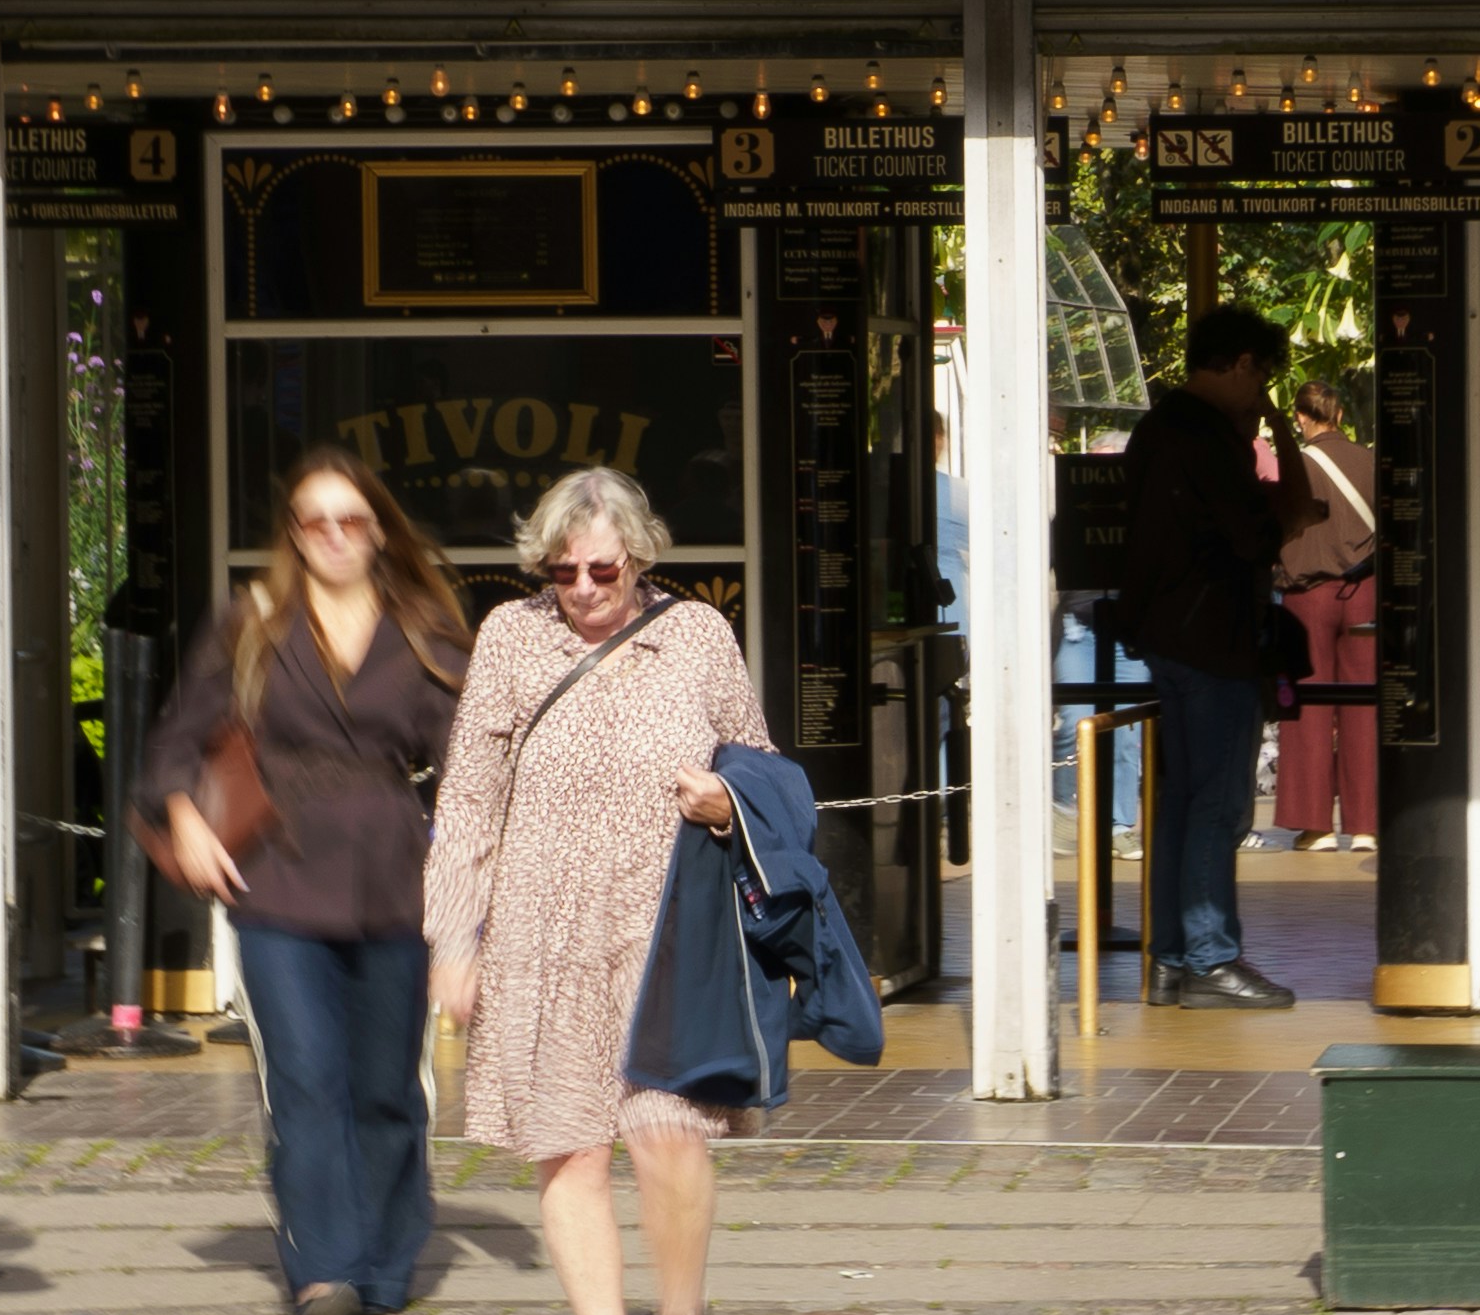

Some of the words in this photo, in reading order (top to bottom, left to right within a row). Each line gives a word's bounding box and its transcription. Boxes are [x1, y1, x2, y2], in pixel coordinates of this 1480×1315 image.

[7, 127, 87, 153] LLETHUS
[824, 126, 935, 149] BILLETHUS
[1282, 121, 1394, 145] BILLETHUS
[140, 135, 165, 175] 4
[734, 133, 761, 174] 3
[1272, 150, 1326, 173] TICKET
[1331, 148, 1406, 172] COUNTER
[32, 156, 98, 181] COUNTER
[813, 156, 868, 178] TICKET
[874, 155, 946, 177] COUNTER
[724, 202, 781, 218] INDGANG
[786, 202, 802, 217] M.
[806, 201, 880, 217] TIVOLIKORT
[1160, 198, 1217, 214] INDGANG
[1222, 198, 1238, 213] M.
[1243, 197, 1316, 213] TIVOLIKORT
[337, 397, 651, 475] TIVOLI
[1071, 465, 1127, 485] UDGAN
[1084, 525, 1127, 545] EXIT
